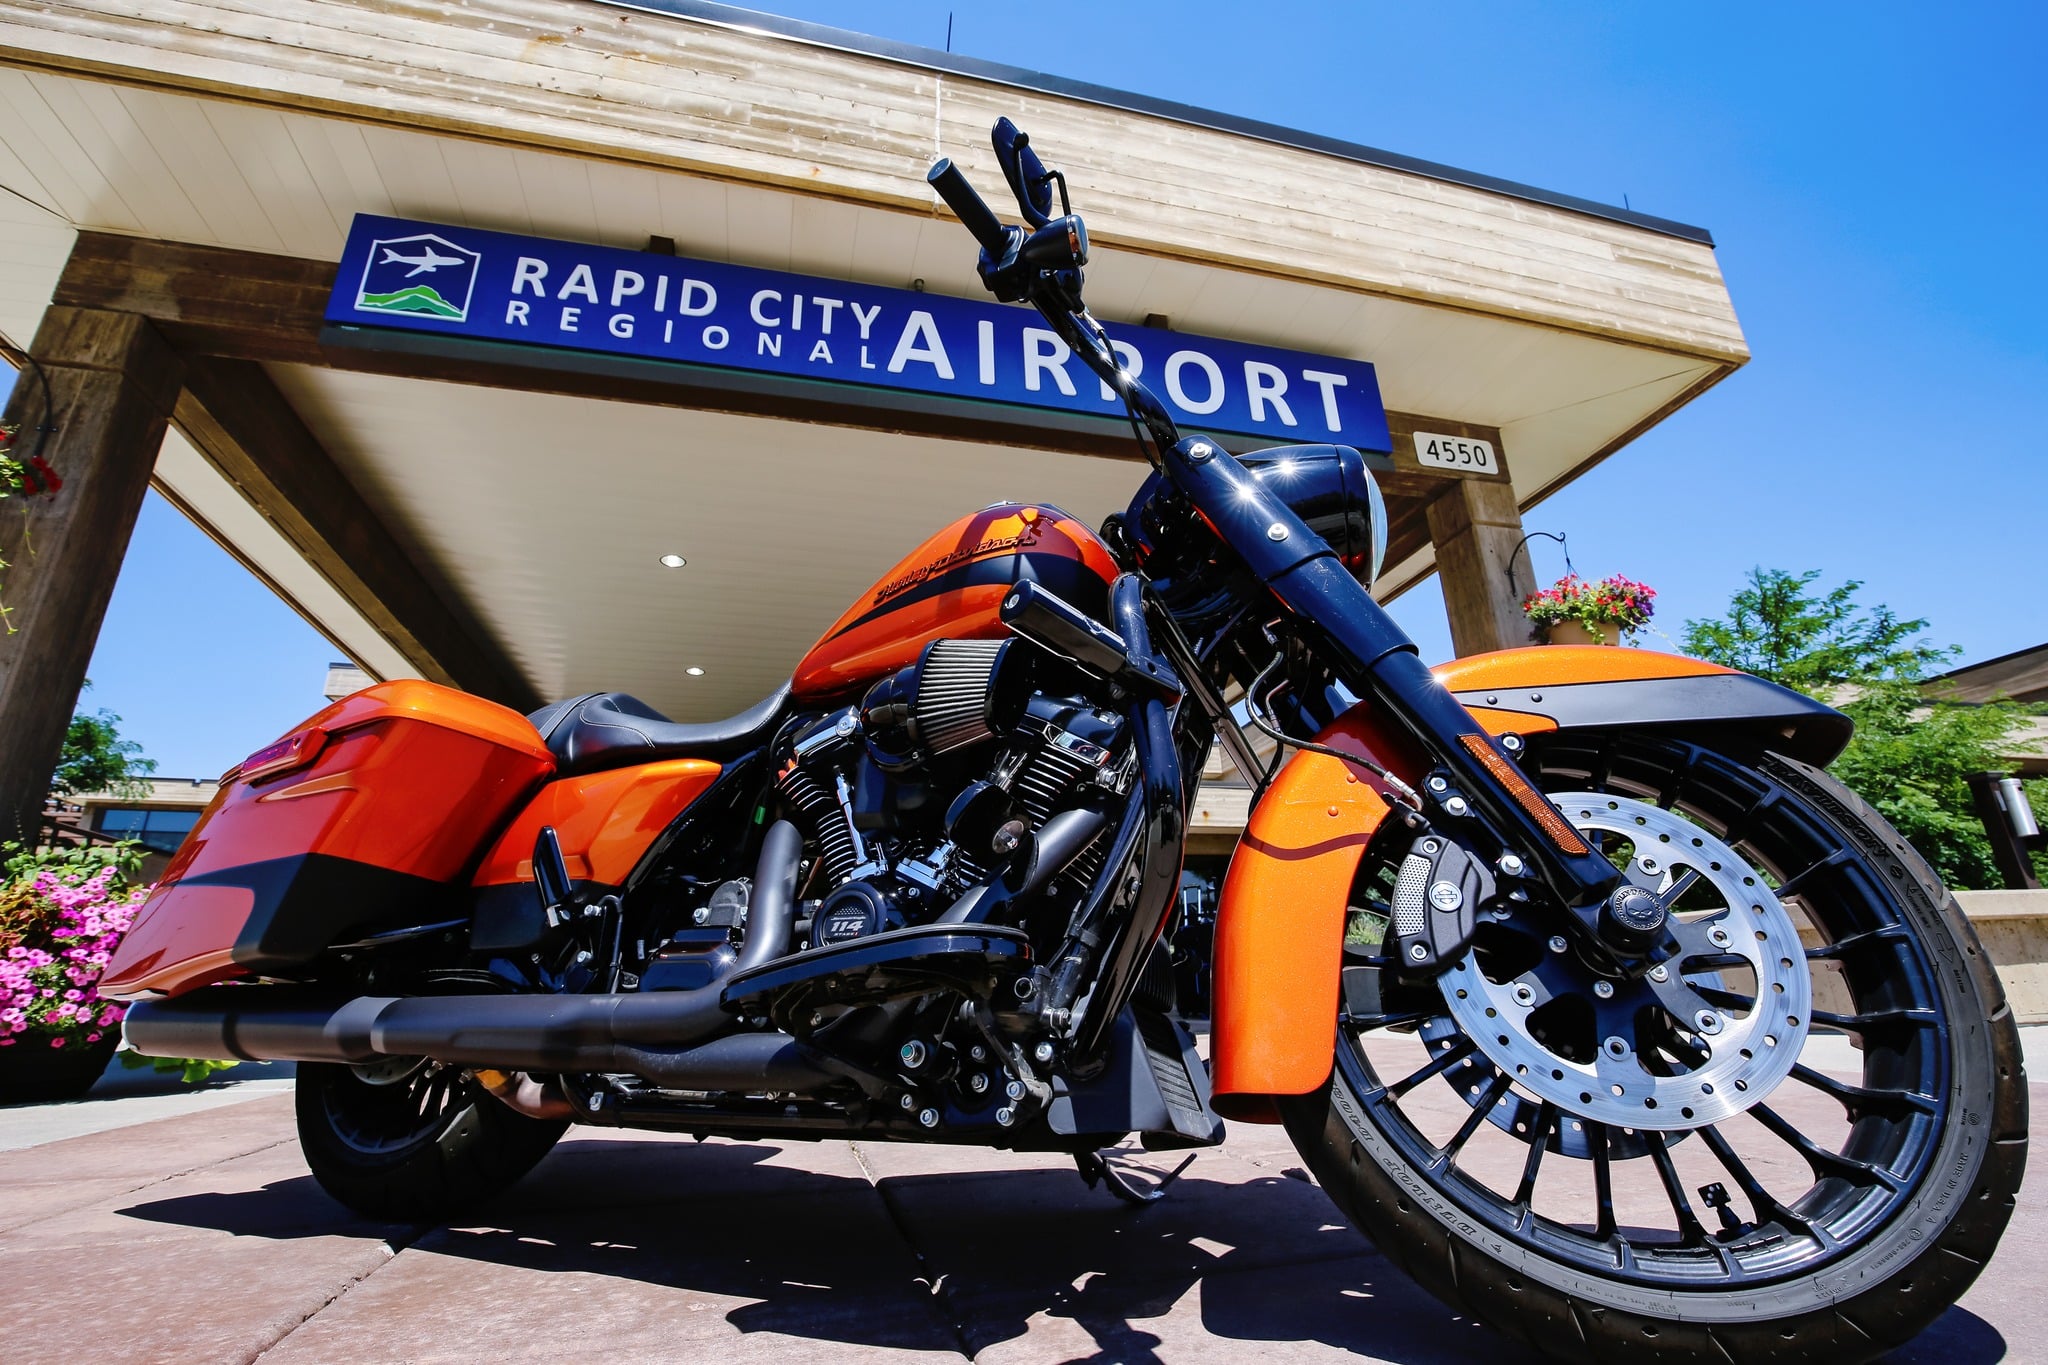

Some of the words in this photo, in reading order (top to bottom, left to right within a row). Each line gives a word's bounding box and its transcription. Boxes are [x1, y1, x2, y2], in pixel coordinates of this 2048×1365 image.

[506, 300, 876, 369] REGIONAL
[511, 257, 717, 317] RAPID
[749, 289, 881, 340] CITY
[887, 310, 1348, 433] AIRPORT
[1427, 440, 1486, 467] 4550
[831, 920, 864, 932] 114
[1383, 1158, 1477, 1236] DUNLOP
